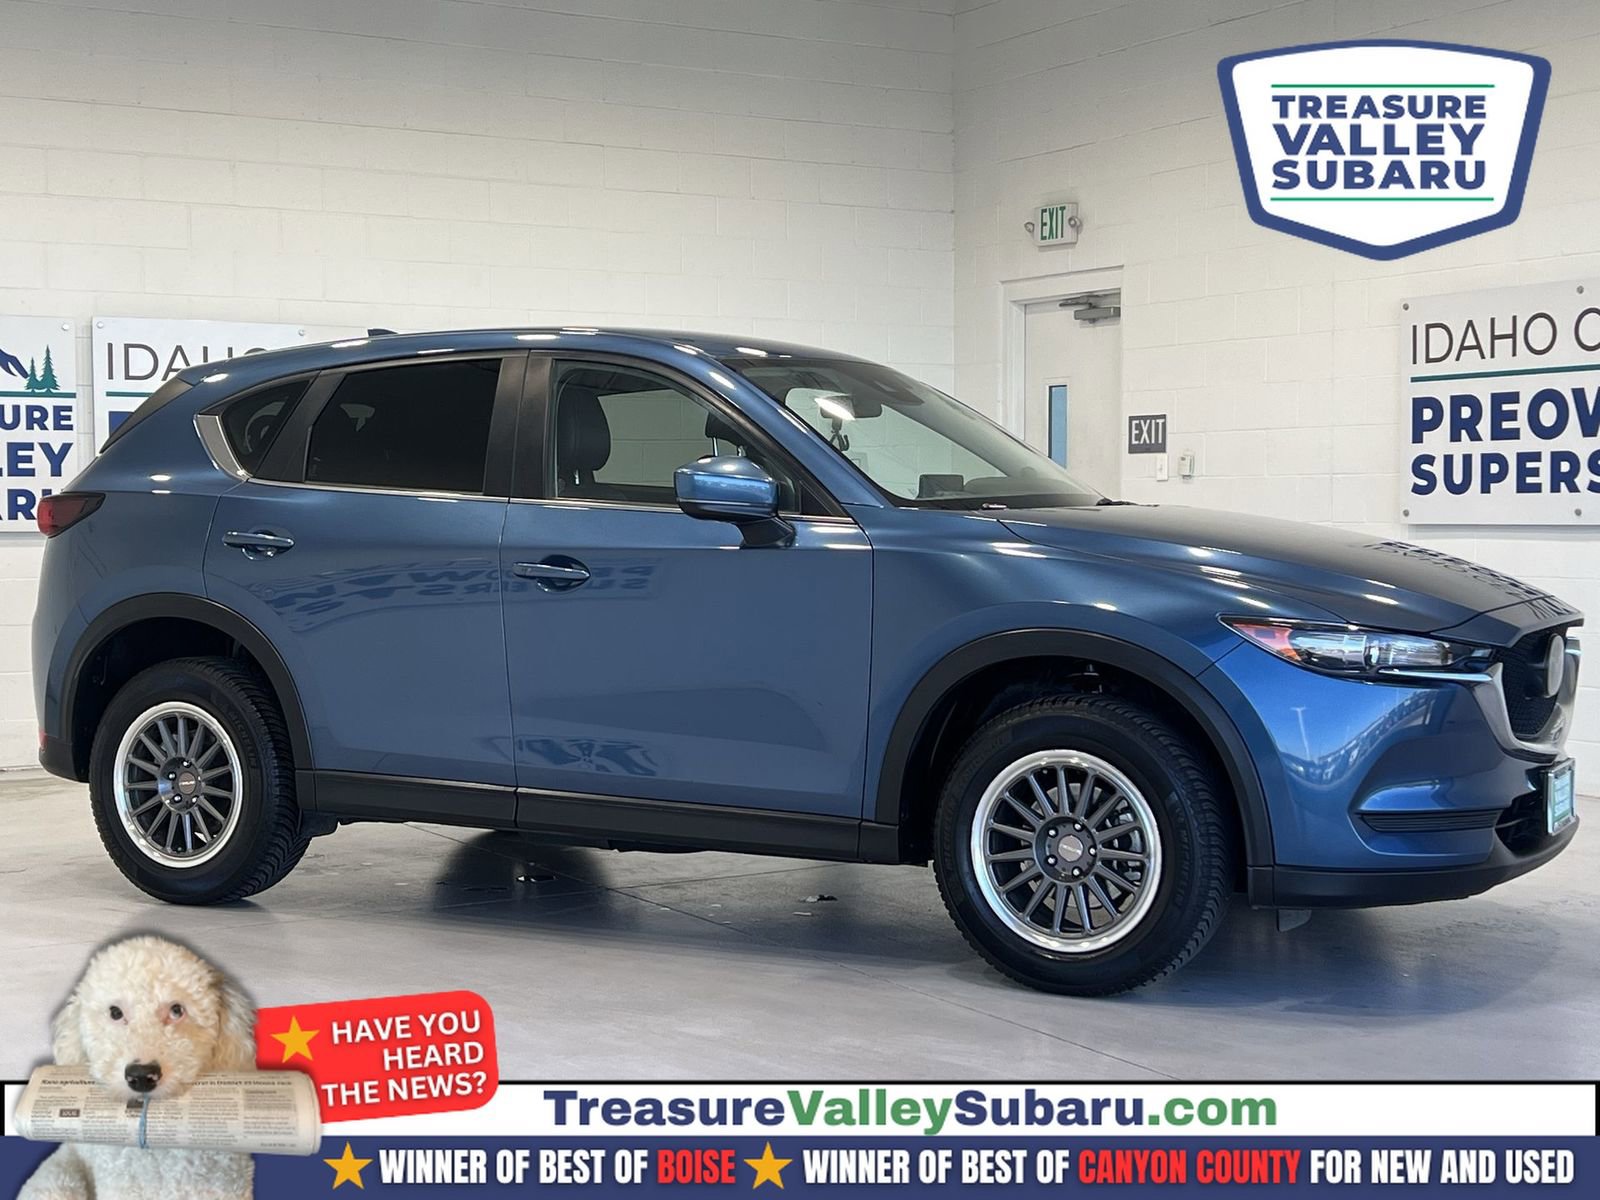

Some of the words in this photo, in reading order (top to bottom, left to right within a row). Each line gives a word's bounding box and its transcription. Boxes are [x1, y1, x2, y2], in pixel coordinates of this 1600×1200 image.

[1040, 206, 1066, 241] EXIT
[1412, 312, 1557, 365] IDAHO
[107, 343, 266, 381] IDA
[1131, 418, 1165, 445] EXIT
[0, 442, 73, 477] EY
